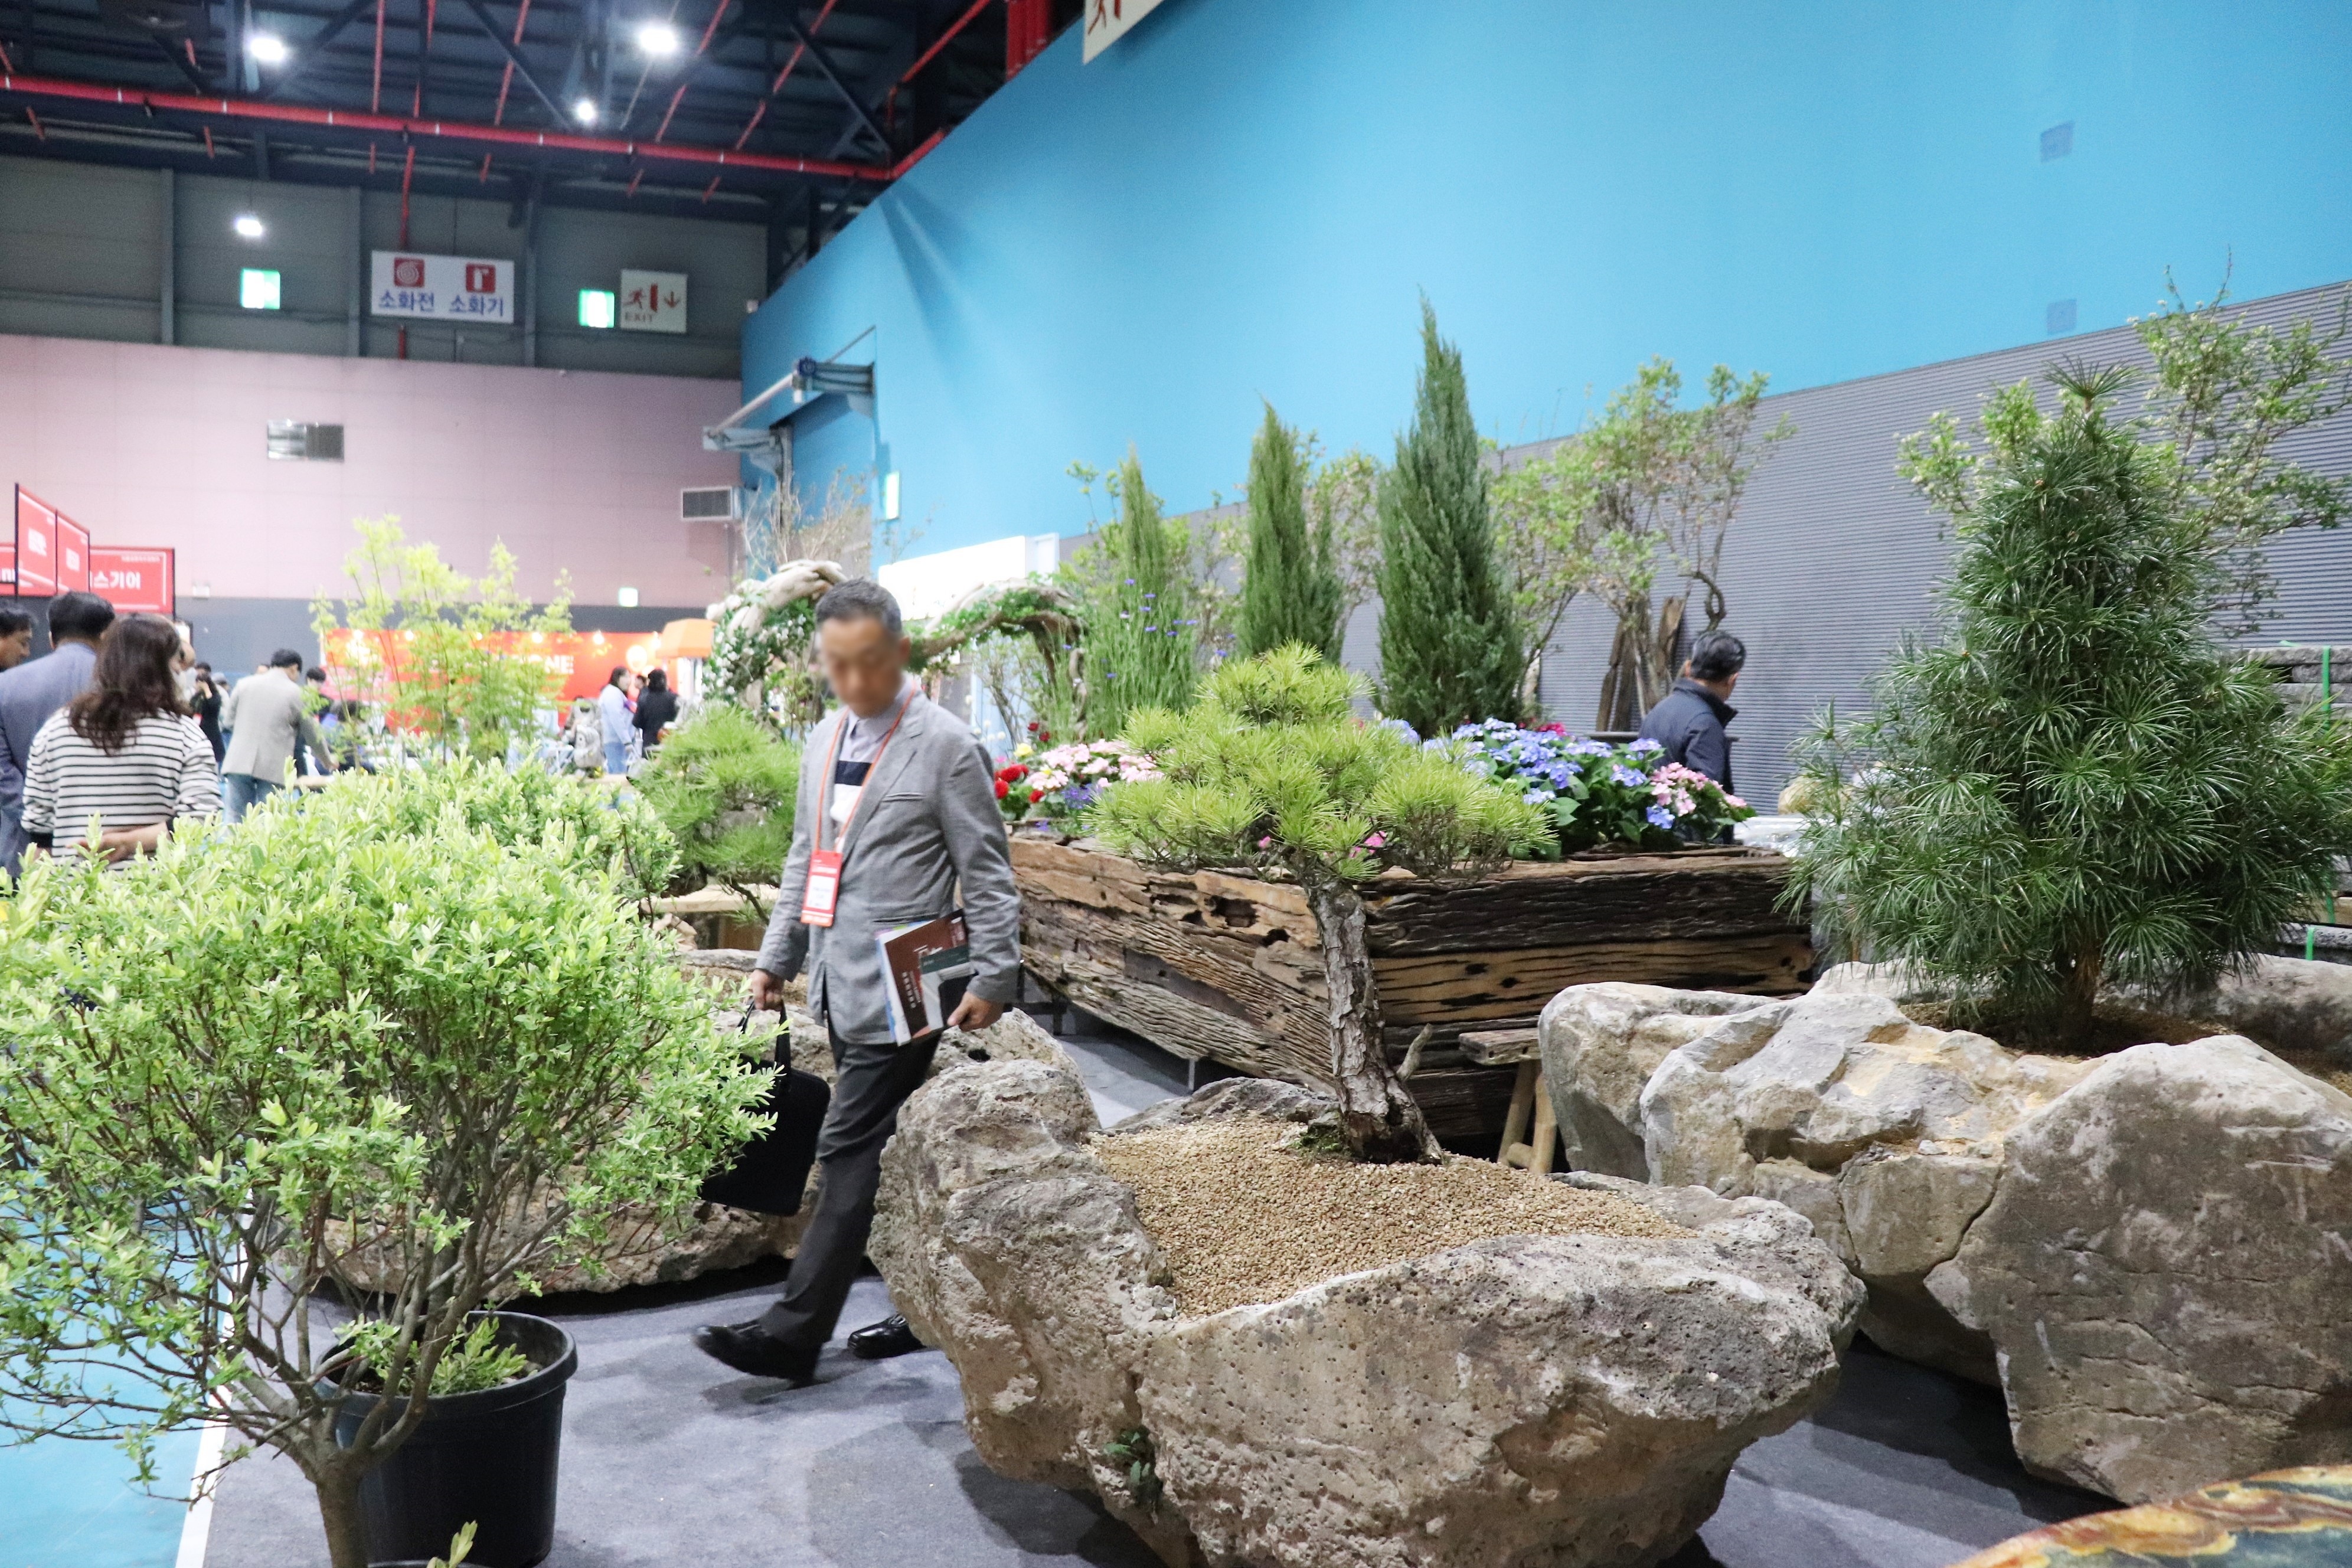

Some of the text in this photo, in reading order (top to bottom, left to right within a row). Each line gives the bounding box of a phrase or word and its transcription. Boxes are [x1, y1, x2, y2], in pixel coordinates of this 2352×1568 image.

[378, 290, 504, 317] 소화전 소화기
[625, 312, 653, 322] EXIT
